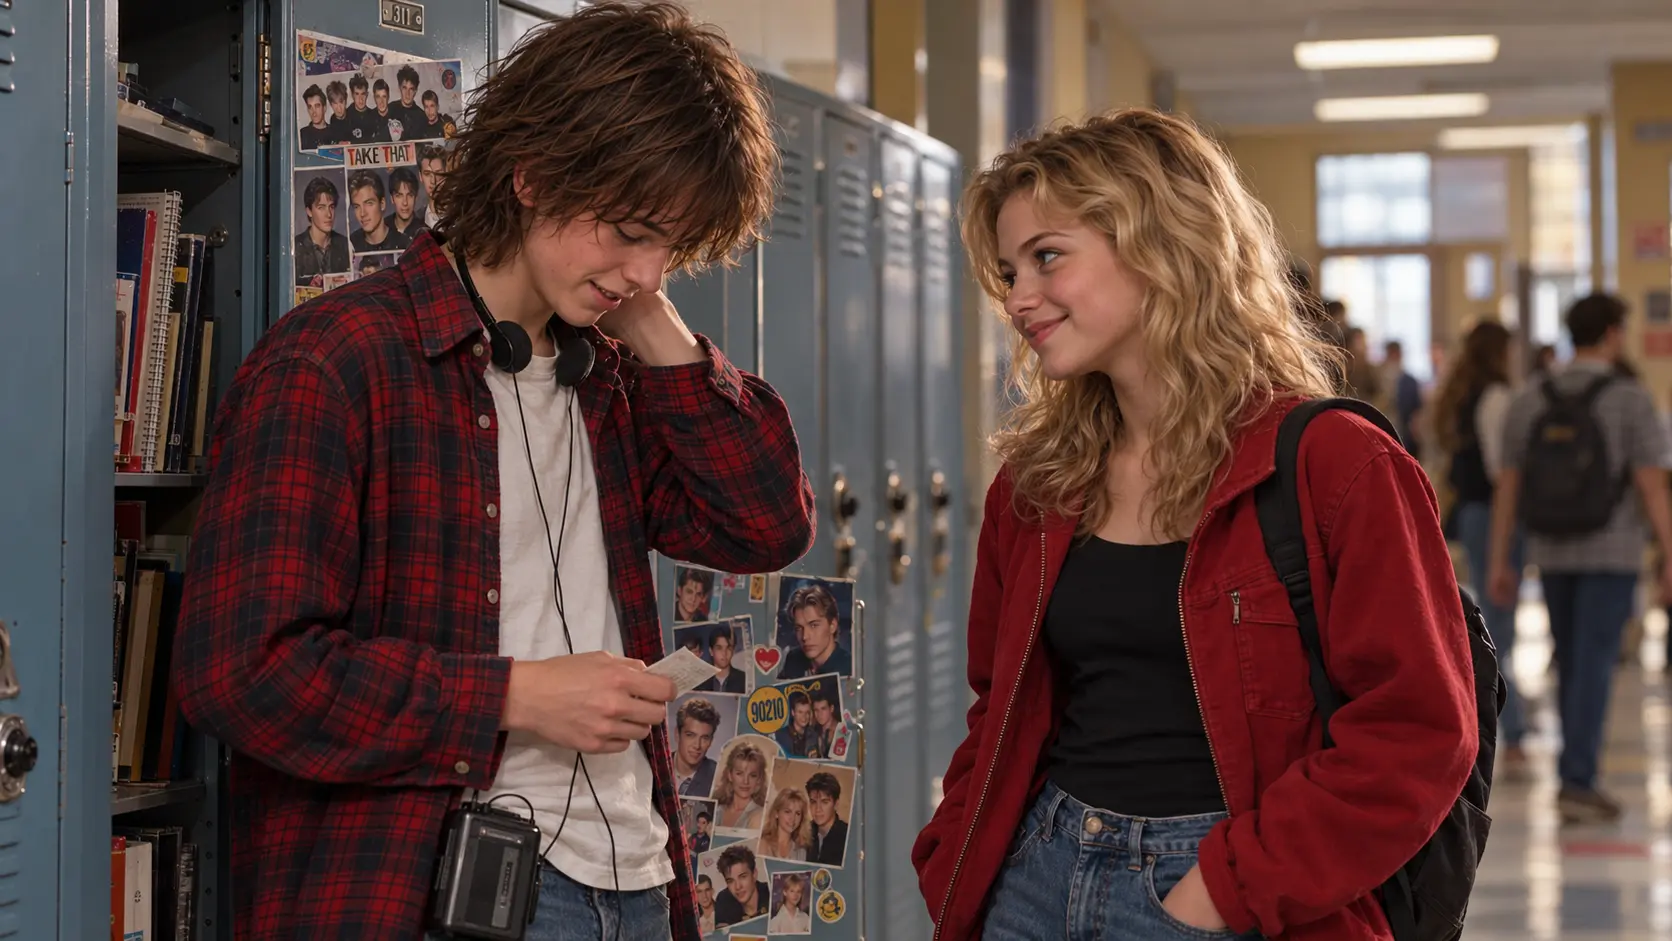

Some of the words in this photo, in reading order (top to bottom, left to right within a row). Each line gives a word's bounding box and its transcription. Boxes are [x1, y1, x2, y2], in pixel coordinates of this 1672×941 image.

[393, 5, 411, 26] 311
[347, 147, 380, 166] TAKE
[382, 144, 411, 163] THAT
[751, 697, 784, 724] 90210
